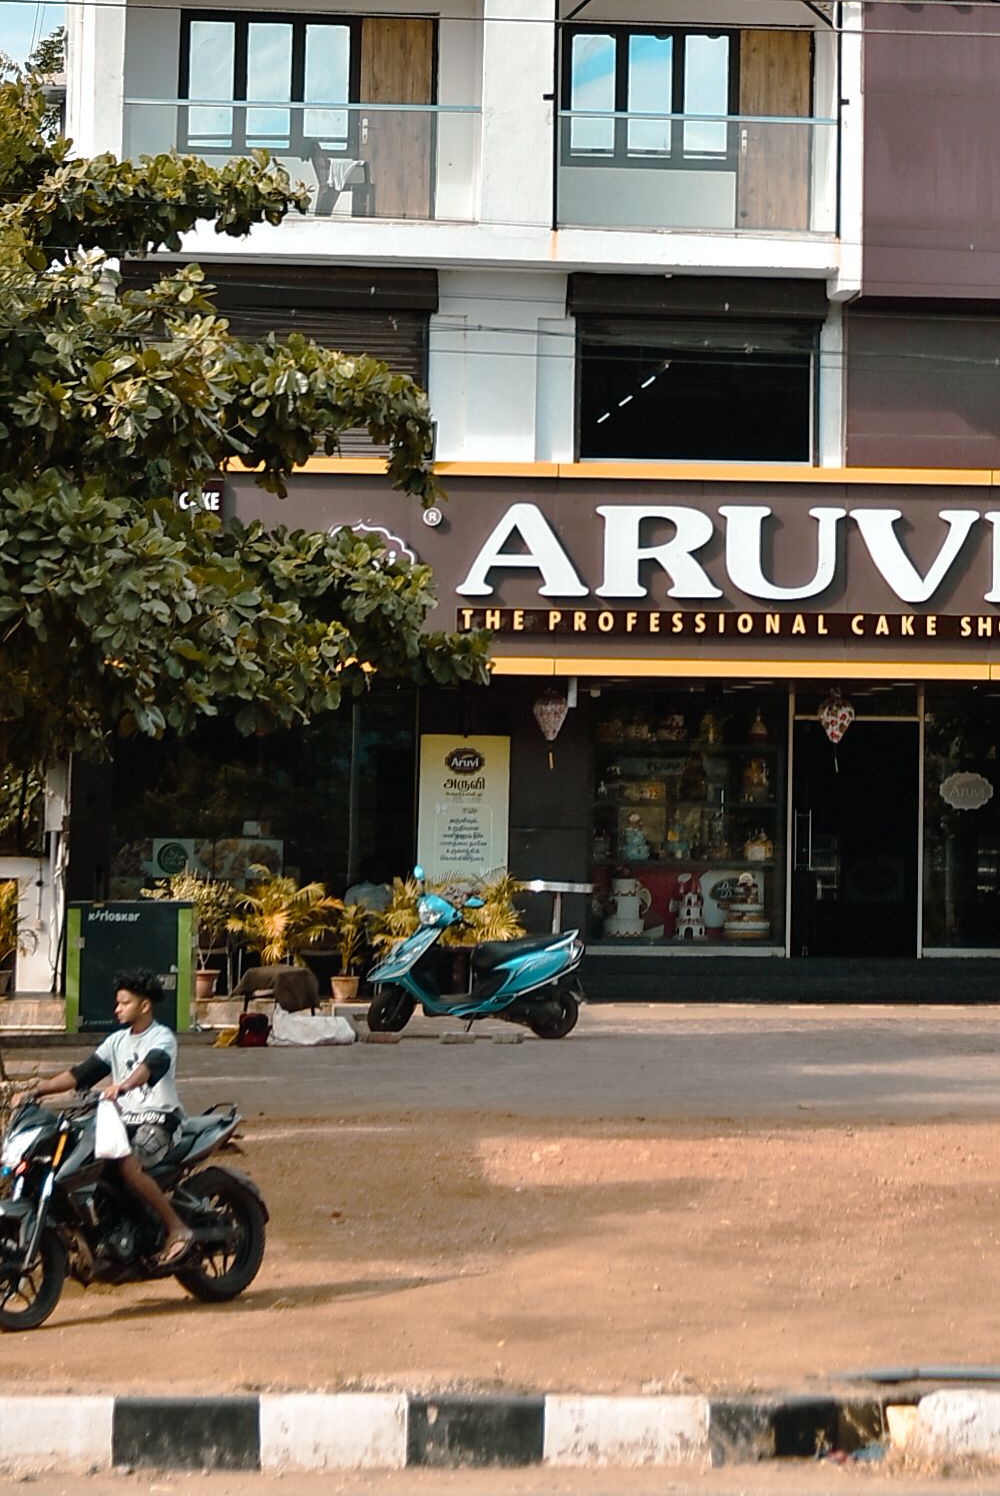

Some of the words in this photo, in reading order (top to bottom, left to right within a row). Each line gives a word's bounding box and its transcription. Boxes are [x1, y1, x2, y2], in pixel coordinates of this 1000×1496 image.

[179, 491, 220, 511] CKE
[461, 608, 526, 631] THE
[548, 610, 829, 636] PROFESSIONAL
[851, 613, 938, 637] CAKE
